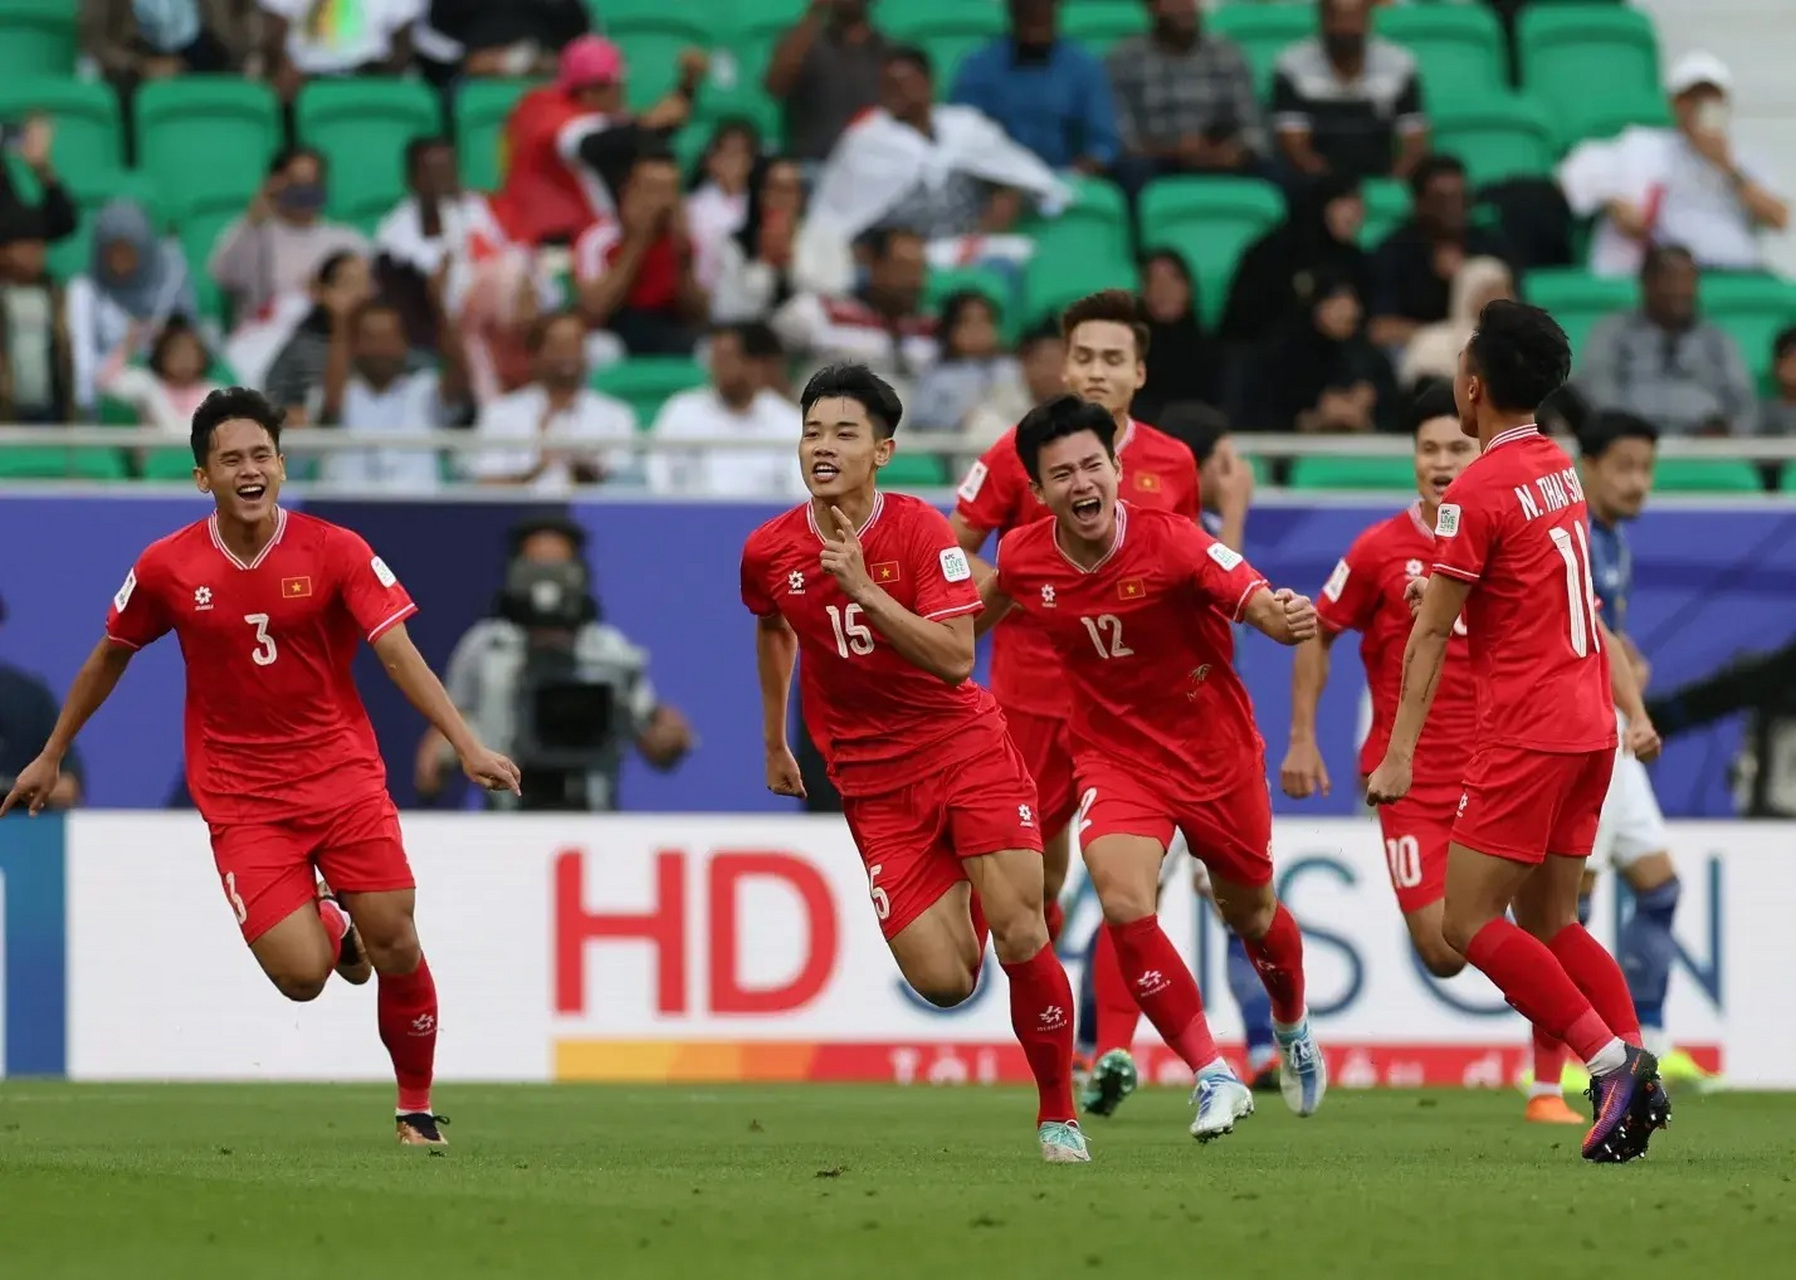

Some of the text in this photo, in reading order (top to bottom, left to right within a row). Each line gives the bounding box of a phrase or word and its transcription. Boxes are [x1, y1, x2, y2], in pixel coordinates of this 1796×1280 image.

[1514, 484, 1544, 521] N.
[1549, 520, 1601, 658] 11
[245, 613, 278, 666] 3
[825, 602, 876, 659] 15
[1080, 614, 1134, 659] 12
[1386, 834, 1423, 890] 10
[225, 871, 248, 925] 3
[869, 863, 890, 920] 5
[552, 846, 1724, 1024] HD ISN
